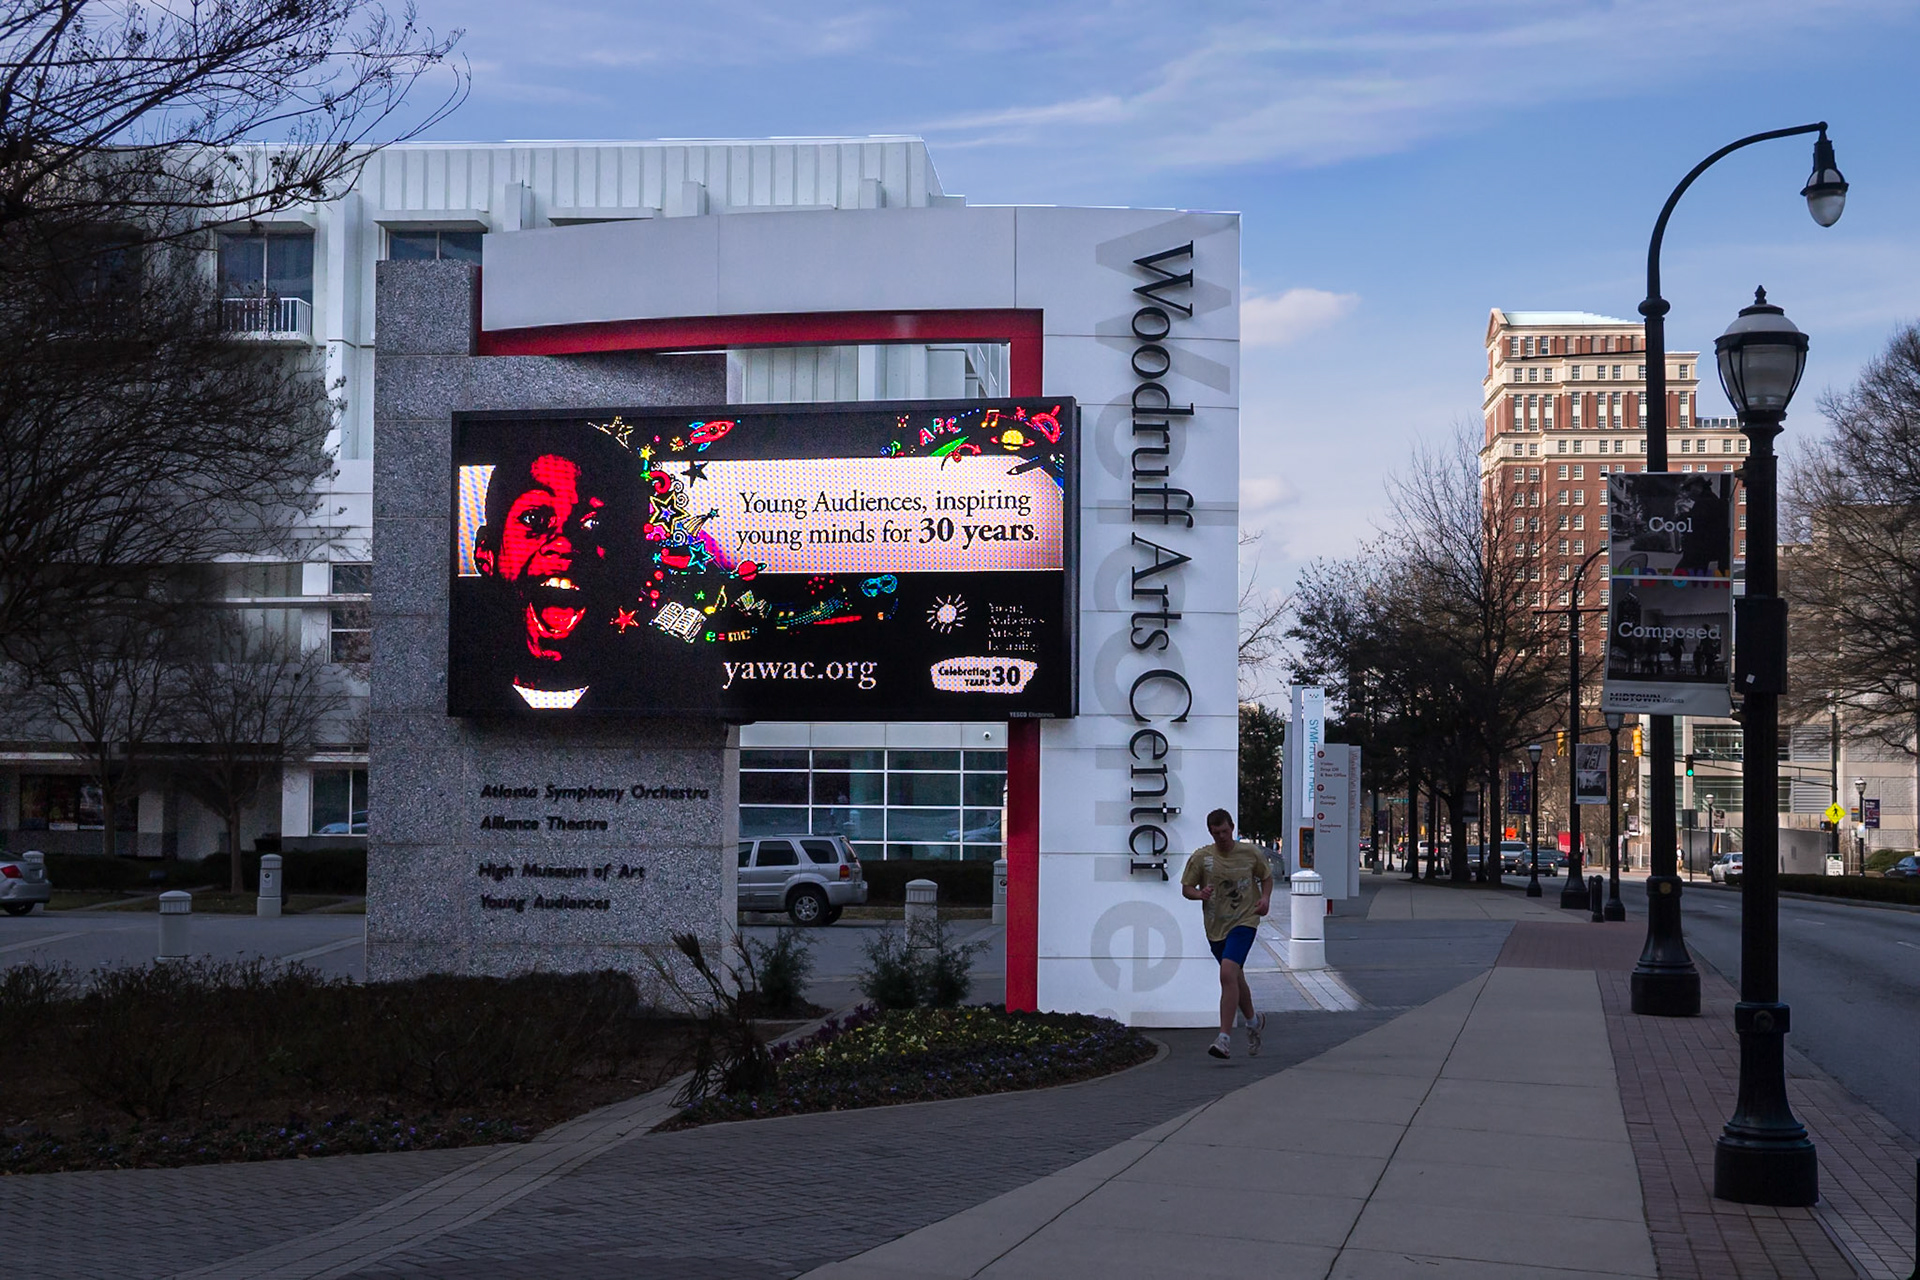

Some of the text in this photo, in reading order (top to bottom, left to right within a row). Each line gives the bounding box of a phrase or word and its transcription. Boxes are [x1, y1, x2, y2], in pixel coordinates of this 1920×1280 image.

[739, 489, 1032, 520] Young Audiences, inspiring
[735, 517, 1040, 552] young minds for 30 years.
[1648, 516, 1694, 533] Cool
[1128, 239, 1195, 882] Woodruff Arts Center
[1611, 567, 1731, 589] MIDTOWN
[1617, 621, 1721, 643] Composed
[722, 661, 878, 690] yawac.org
[938, 665, 1021, 687] Celebrating 30
[1609, 692, 1662, 704] MIDTOWN
[480, 783, 710, 803] Atlanta Symphony Orchestra
[480, 815, 609, 831] Alliance Theatre
[478, 862, 646, 882] High Museum of Art
[480, 894, 611, 912] Young Audiences
